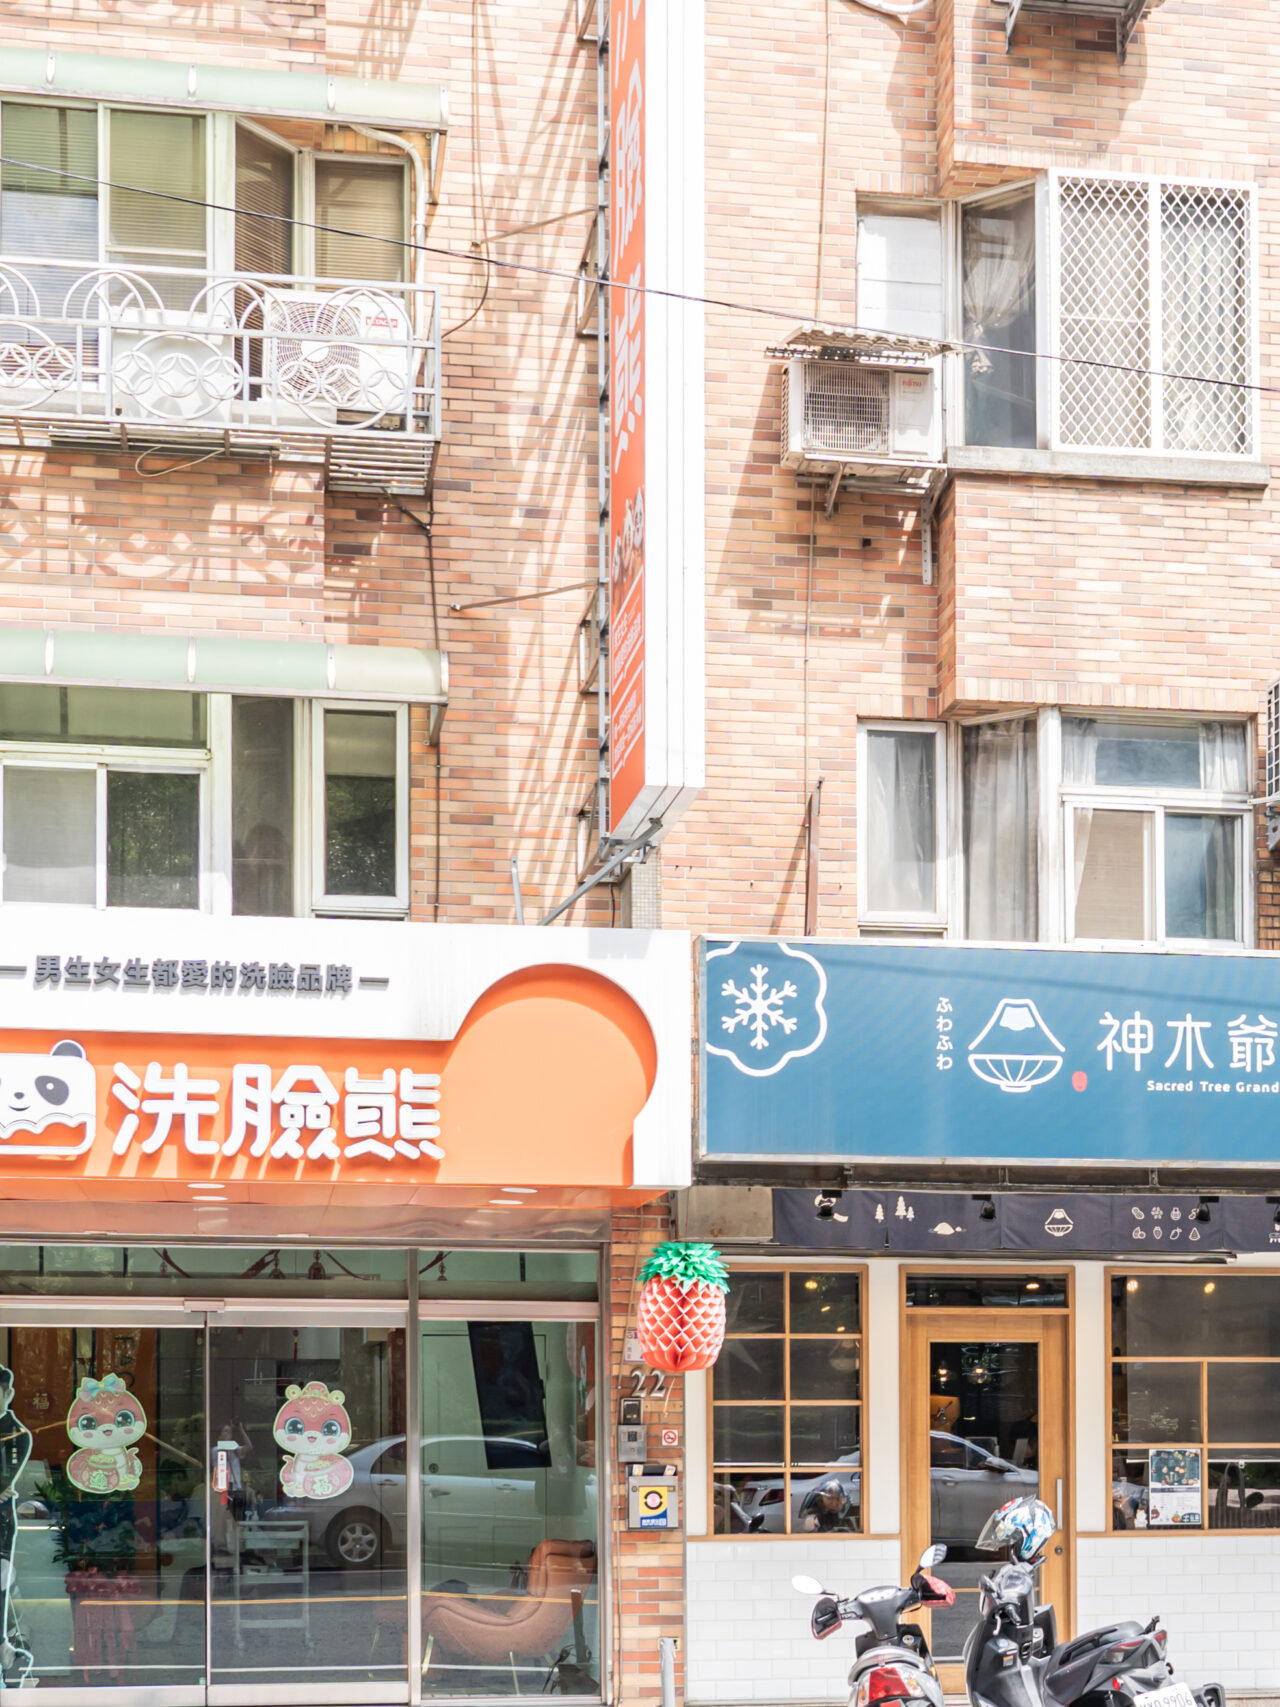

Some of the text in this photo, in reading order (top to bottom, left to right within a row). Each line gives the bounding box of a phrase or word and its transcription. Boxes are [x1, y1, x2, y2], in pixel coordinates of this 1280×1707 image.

[935, 996, 954, 1071] ふわふわ
[1146, 1079, 1194, 1093] Sacred
[1199, 1080, 1231, 1094] Tree
[111, 1060, 446, 1161] 洗臉熊
[631, 1368, 667, 1398] 22
[32, 1392, 50, 1410] 福
